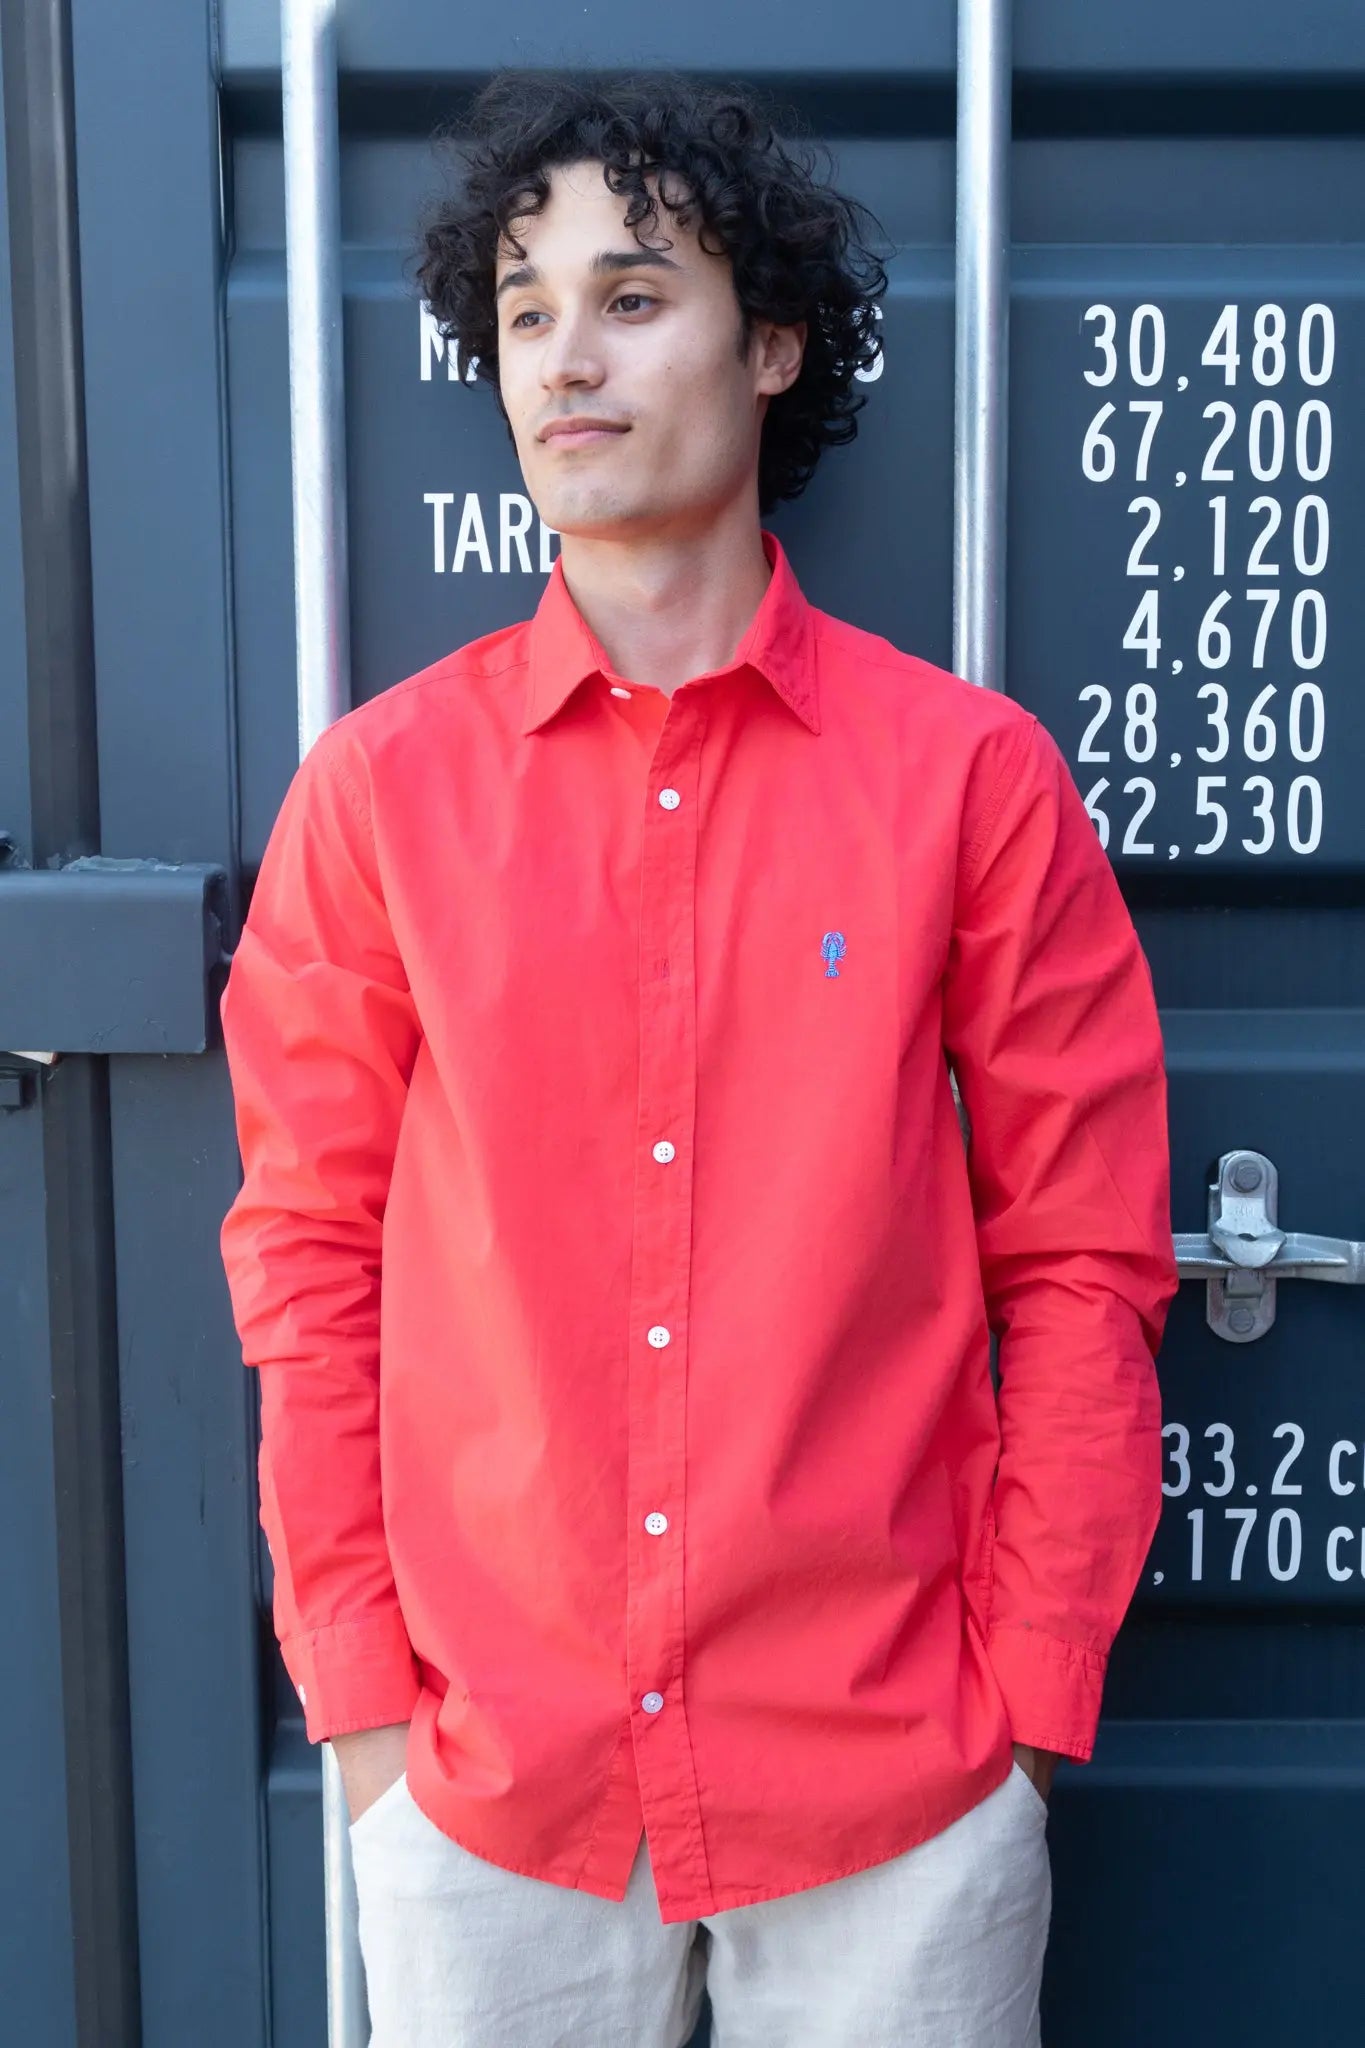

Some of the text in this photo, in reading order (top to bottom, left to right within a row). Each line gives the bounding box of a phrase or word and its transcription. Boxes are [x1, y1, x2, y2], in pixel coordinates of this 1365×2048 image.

[1083, 303, 1335, 392] 30,480
[1081, 399, 1332, 487] 67,200
[1126, 494, 1330, 582] 2,120
[1122, 588, 1327, 675] 4,670
[1077, 682, 1325, 768] 28,360
[1161, 1422, 1365, 1497] 33.2 c
[1153, 1507, 1365, 1586] ,170 c
